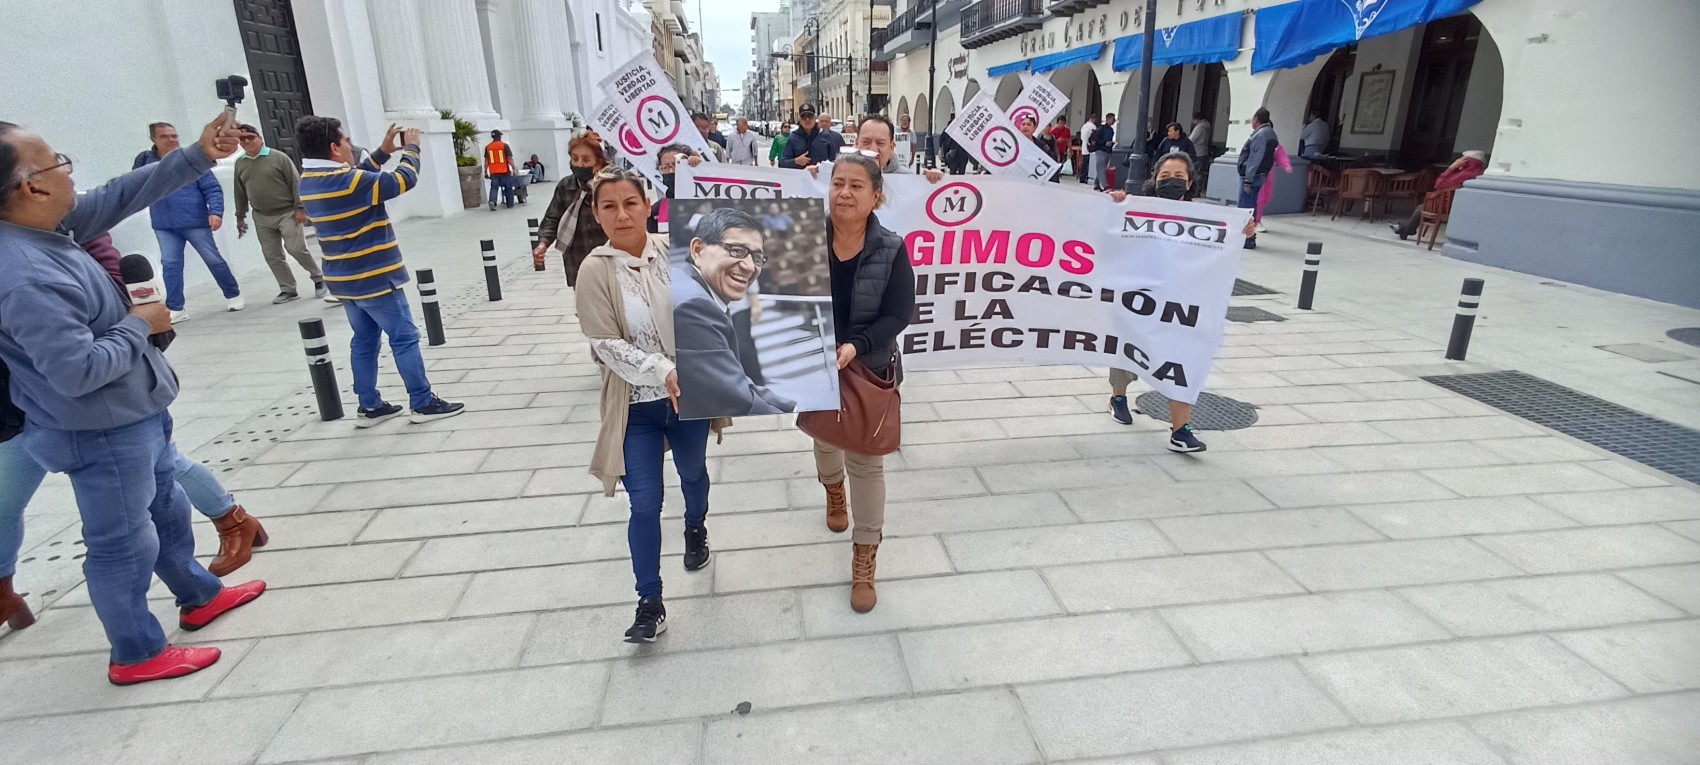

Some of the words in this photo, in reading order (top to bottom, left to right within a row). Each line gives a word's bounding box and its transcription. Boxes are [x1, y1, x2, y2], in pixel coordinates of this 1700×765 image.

[618, 74, 647, 97] VERDAD
[624, 78, 656, 103] LIBERTAD
[597, 103, 615, 121] JUSTICI
[607, 114, 623, 132] LIBERT
[962, 112, 985, 136] VERDAD
[968, 113, 993, 141] LIBERTAD
[904, 229, 1095, 275] GIMOS
[910, 302, 934, 325] E
[954, 299, 1014, 321] LA
[915, 271, 1200, 328] IFICACIÓN
[903, 323, 1189, 388] ELÉCTRICA
